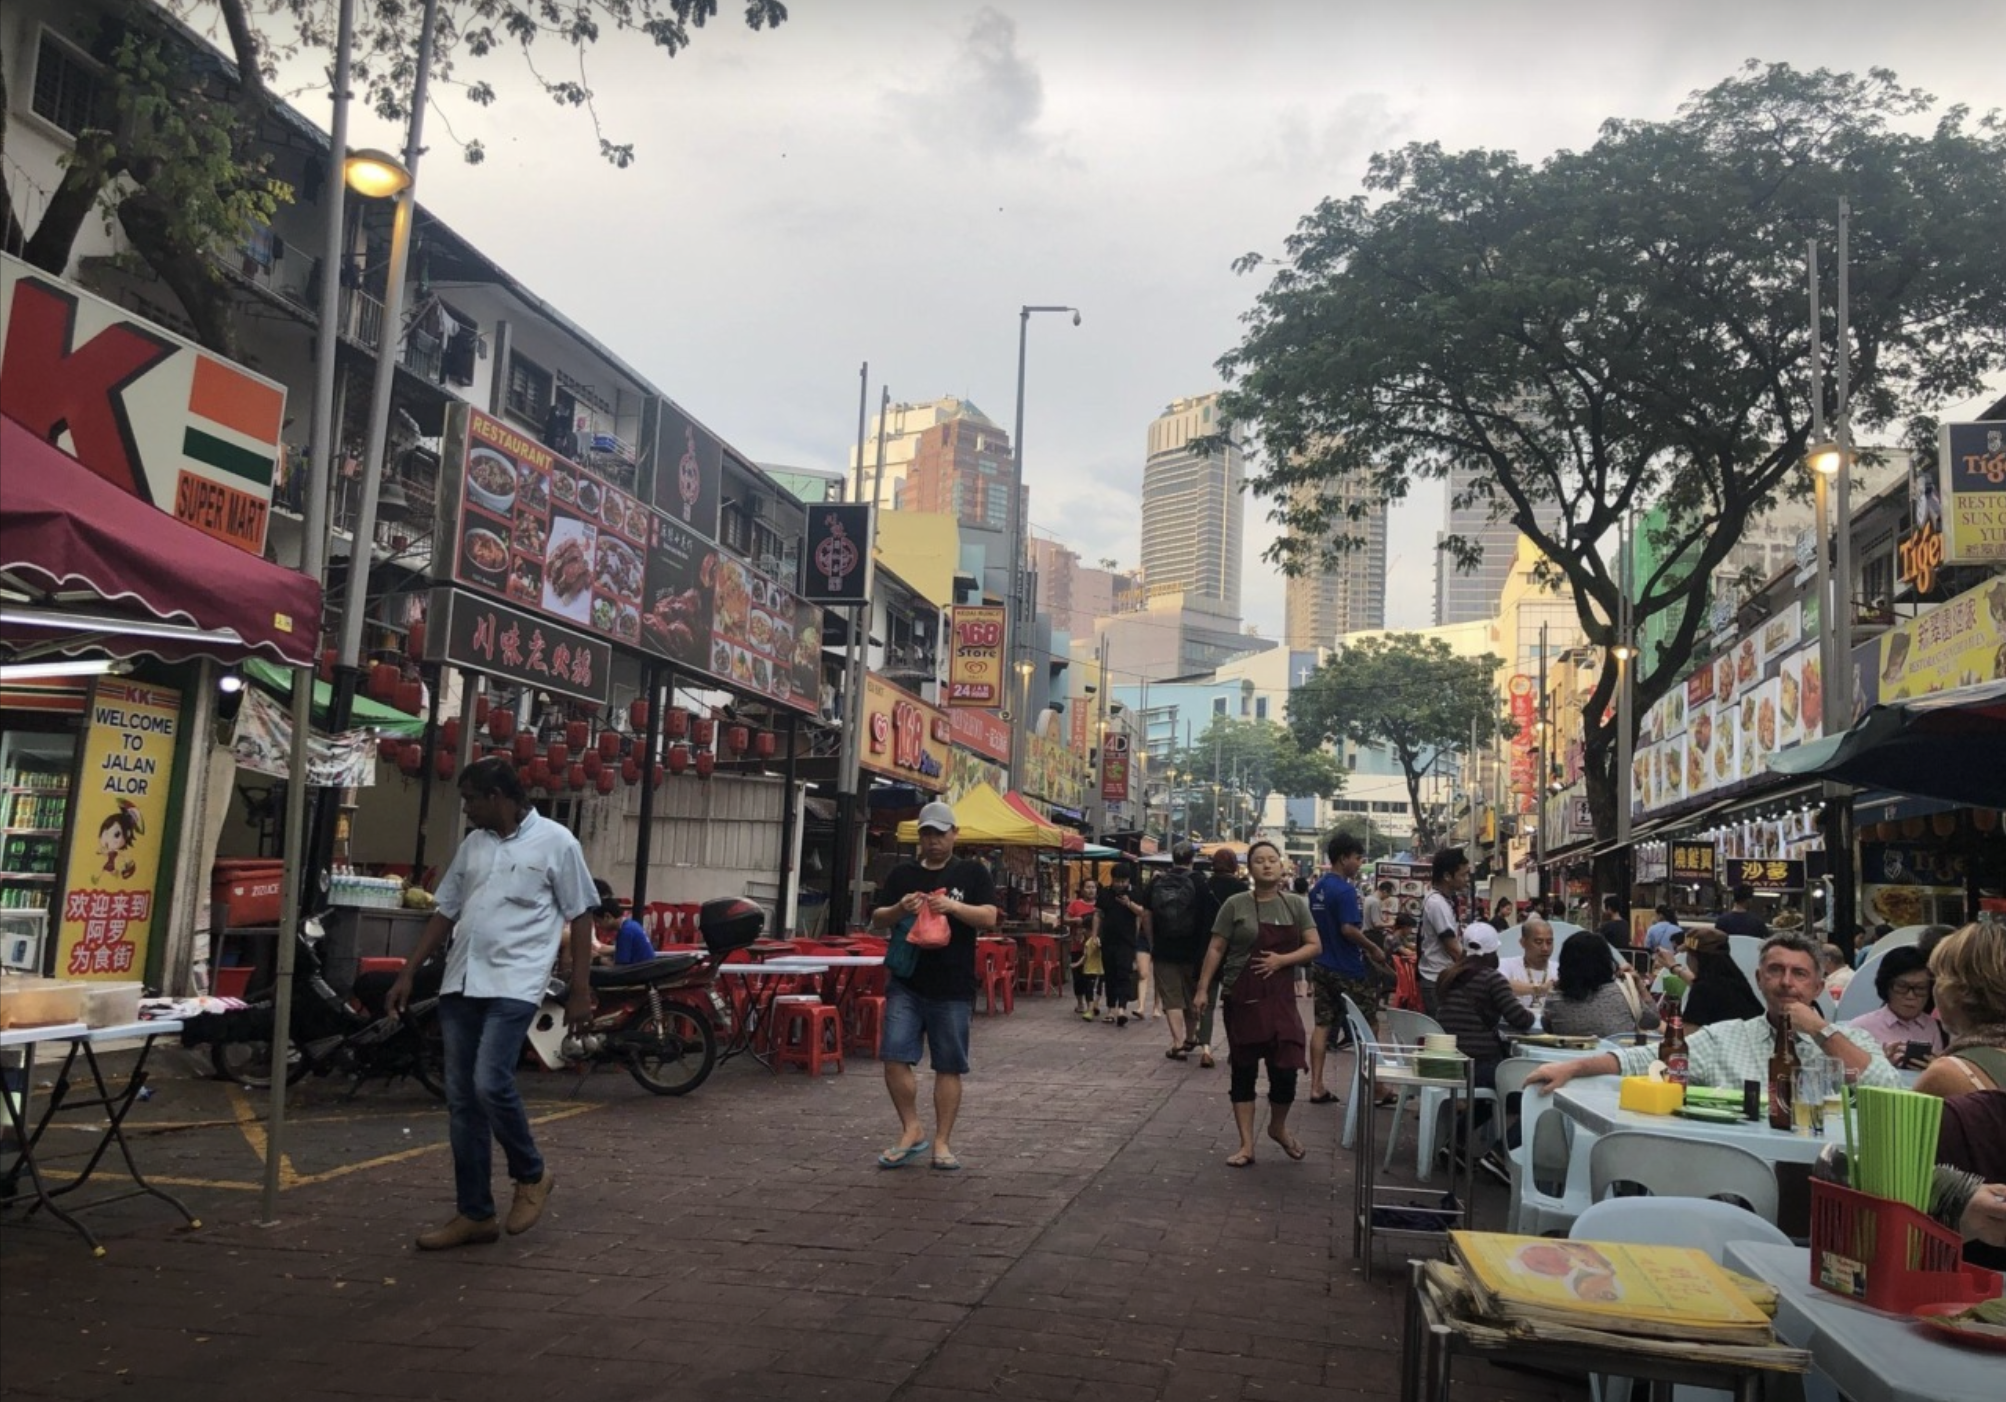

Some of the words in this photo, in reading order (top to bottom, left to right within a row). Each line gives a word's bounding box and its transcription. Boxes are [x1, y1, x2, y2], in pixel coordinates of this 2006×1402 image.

[0, 275, 181, 507] K
[473, 416, 553, 470] RESTAURANT
[179, 477, 225, 531] SUPER
[226, 492, 266, 543] MART
[1962, 513, 1993, 526] SUN
[958, 622, 1000, 647] 168
[957, 647, 997, 658] Store
[125, 685, 151, 705] KK
[953, 684, 971, 697] 24
[96, 706, 173, 735] WELCOME
[123, 733, 143, 750] TO
[896, 702, 923, 769] 168
[1105, 735, 1127, 752] 4D
[102, 754, 155, 774] JALAN
[104, 776, 148, 795] ALOR
[67, 892, 150, 919] 欢迎来到
[86, 919, 127, 944] 阿罗
[71, 944, 133, 971] 为食街
